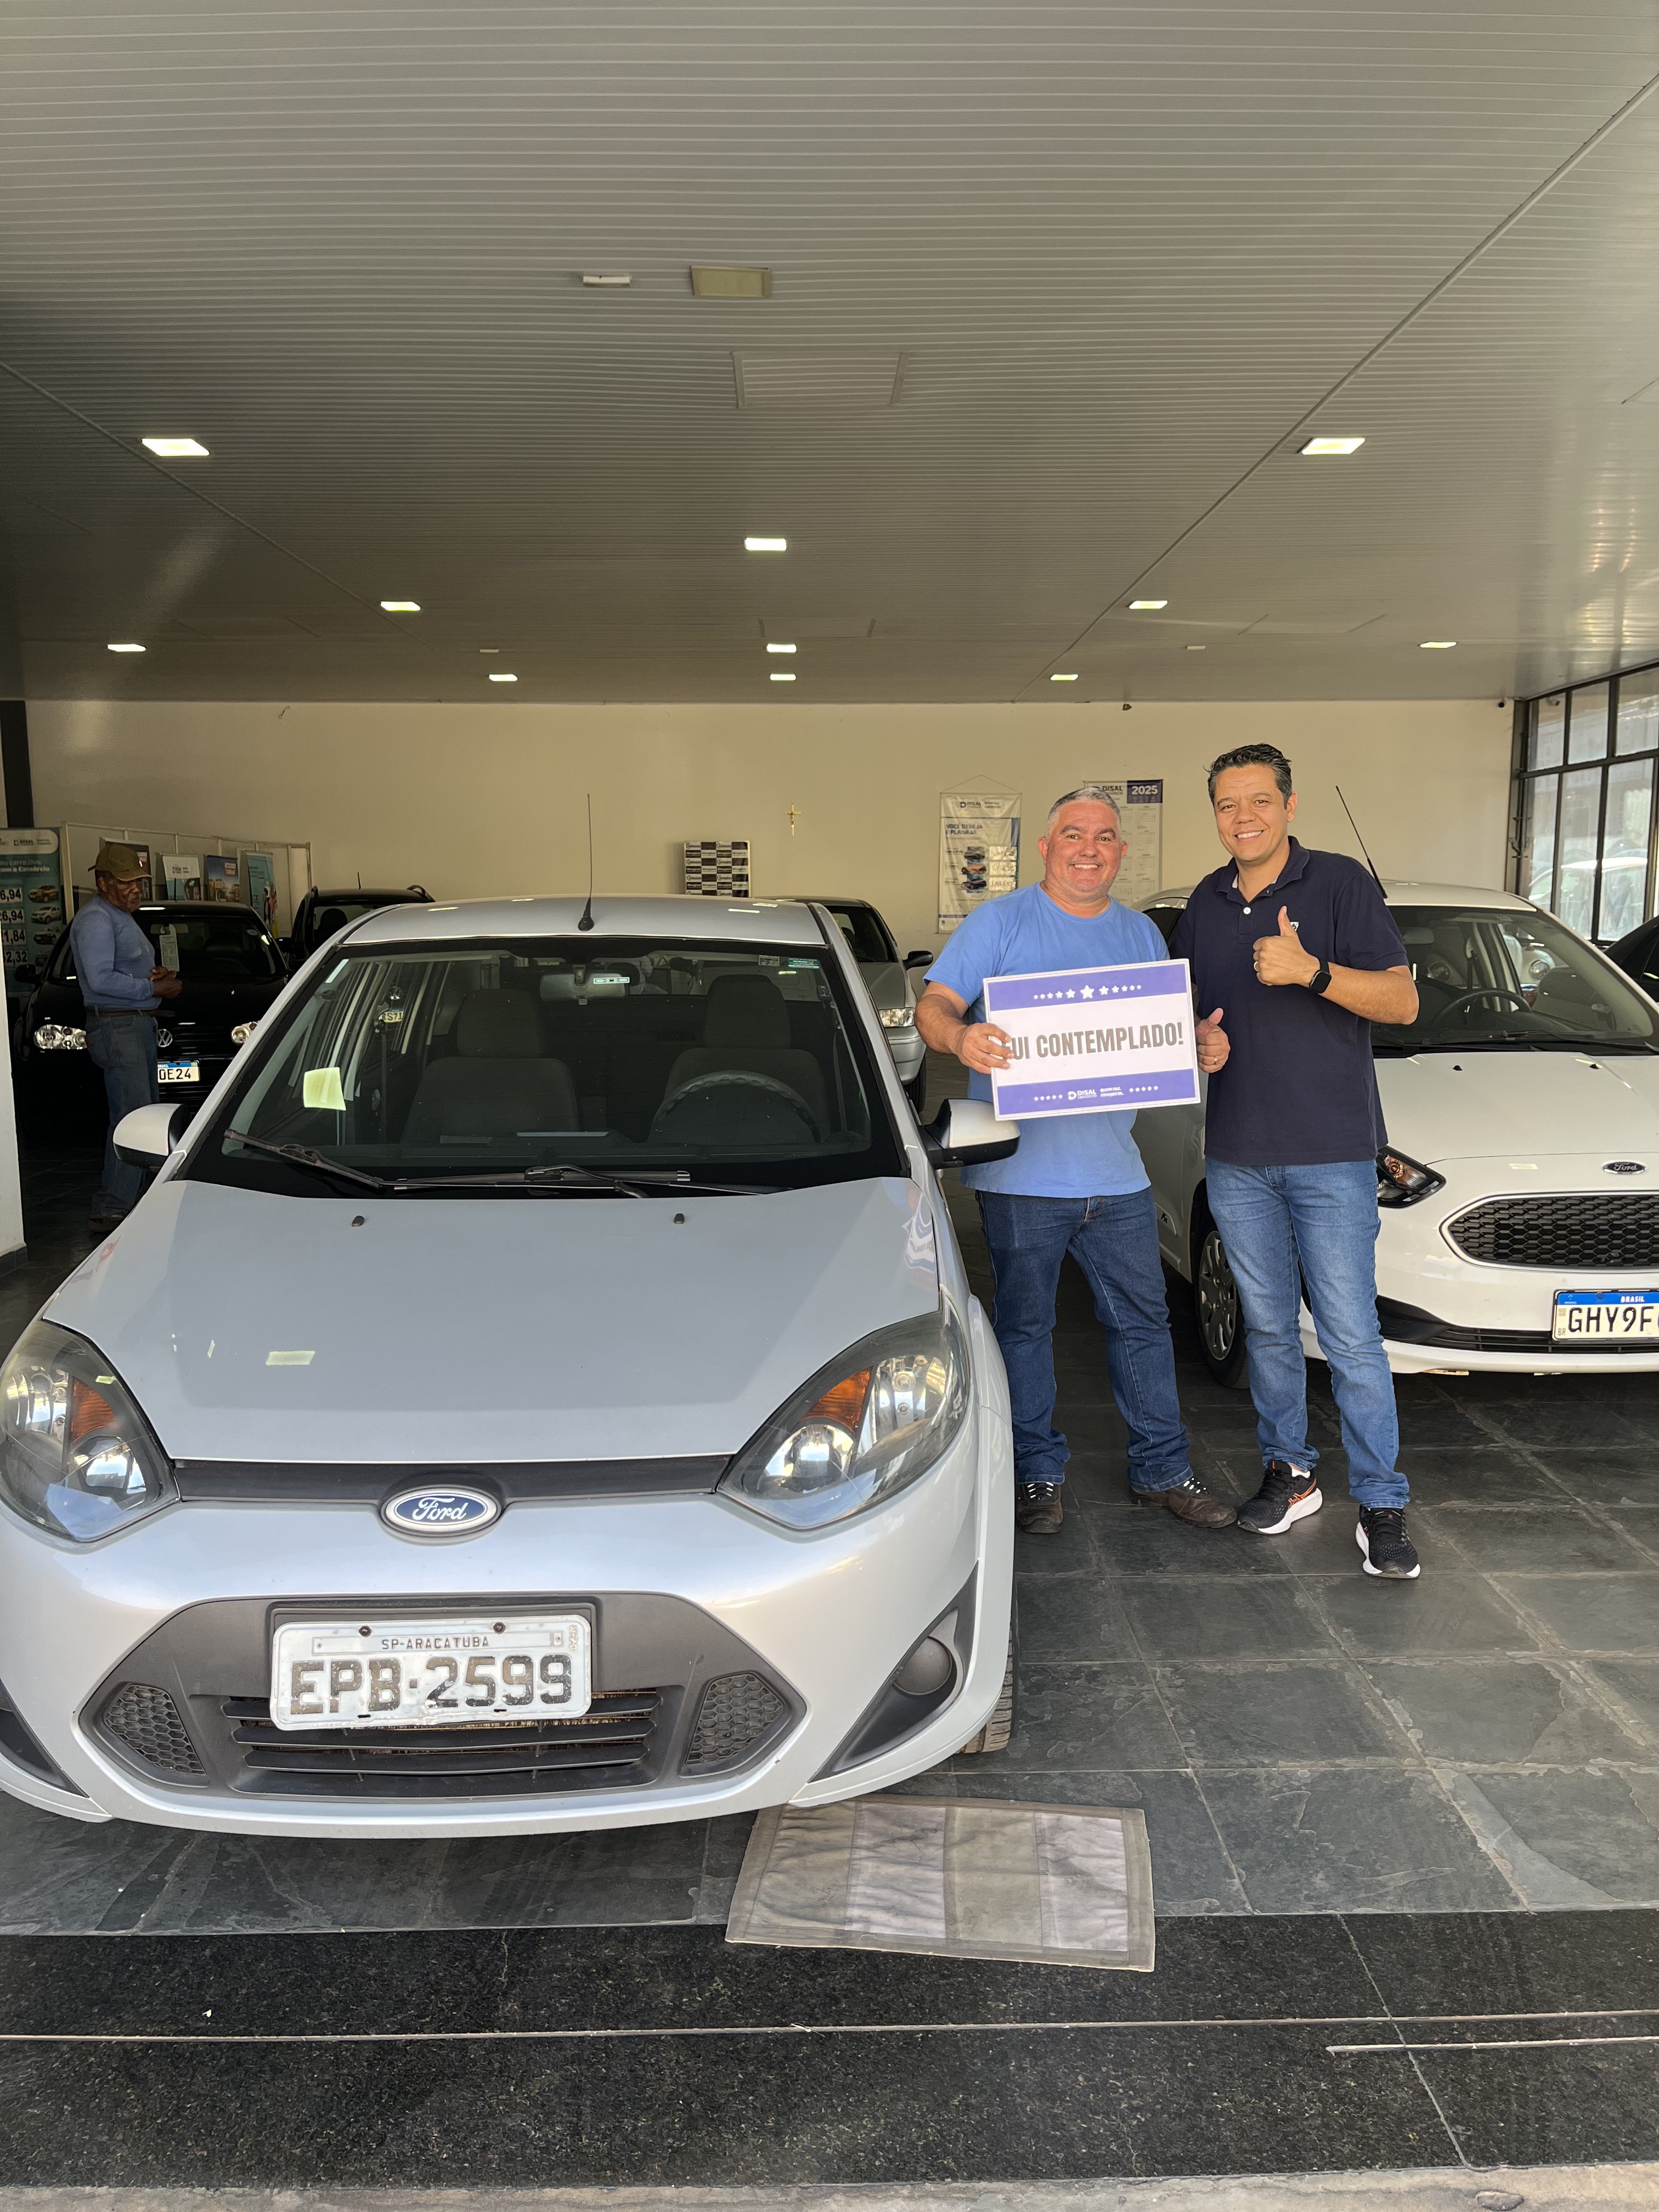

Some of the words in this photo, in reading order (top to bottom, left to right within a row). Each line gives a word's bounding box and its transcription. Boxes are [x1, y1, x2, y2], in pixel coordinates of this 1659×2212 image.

[1131, 785, 1159, 795] 2025
[1002, 1036, 1030, 1060] UI
[1036, 1022, 1184, 1058] CONTEMPLADO!
[1613, 1163, 1638, 1171] Ford
[1568, 1306, 1659, 1333] GHY9F
[1558, 1328, 1566, 1336] BR
[412, 1497, 469, 1521] Ford
